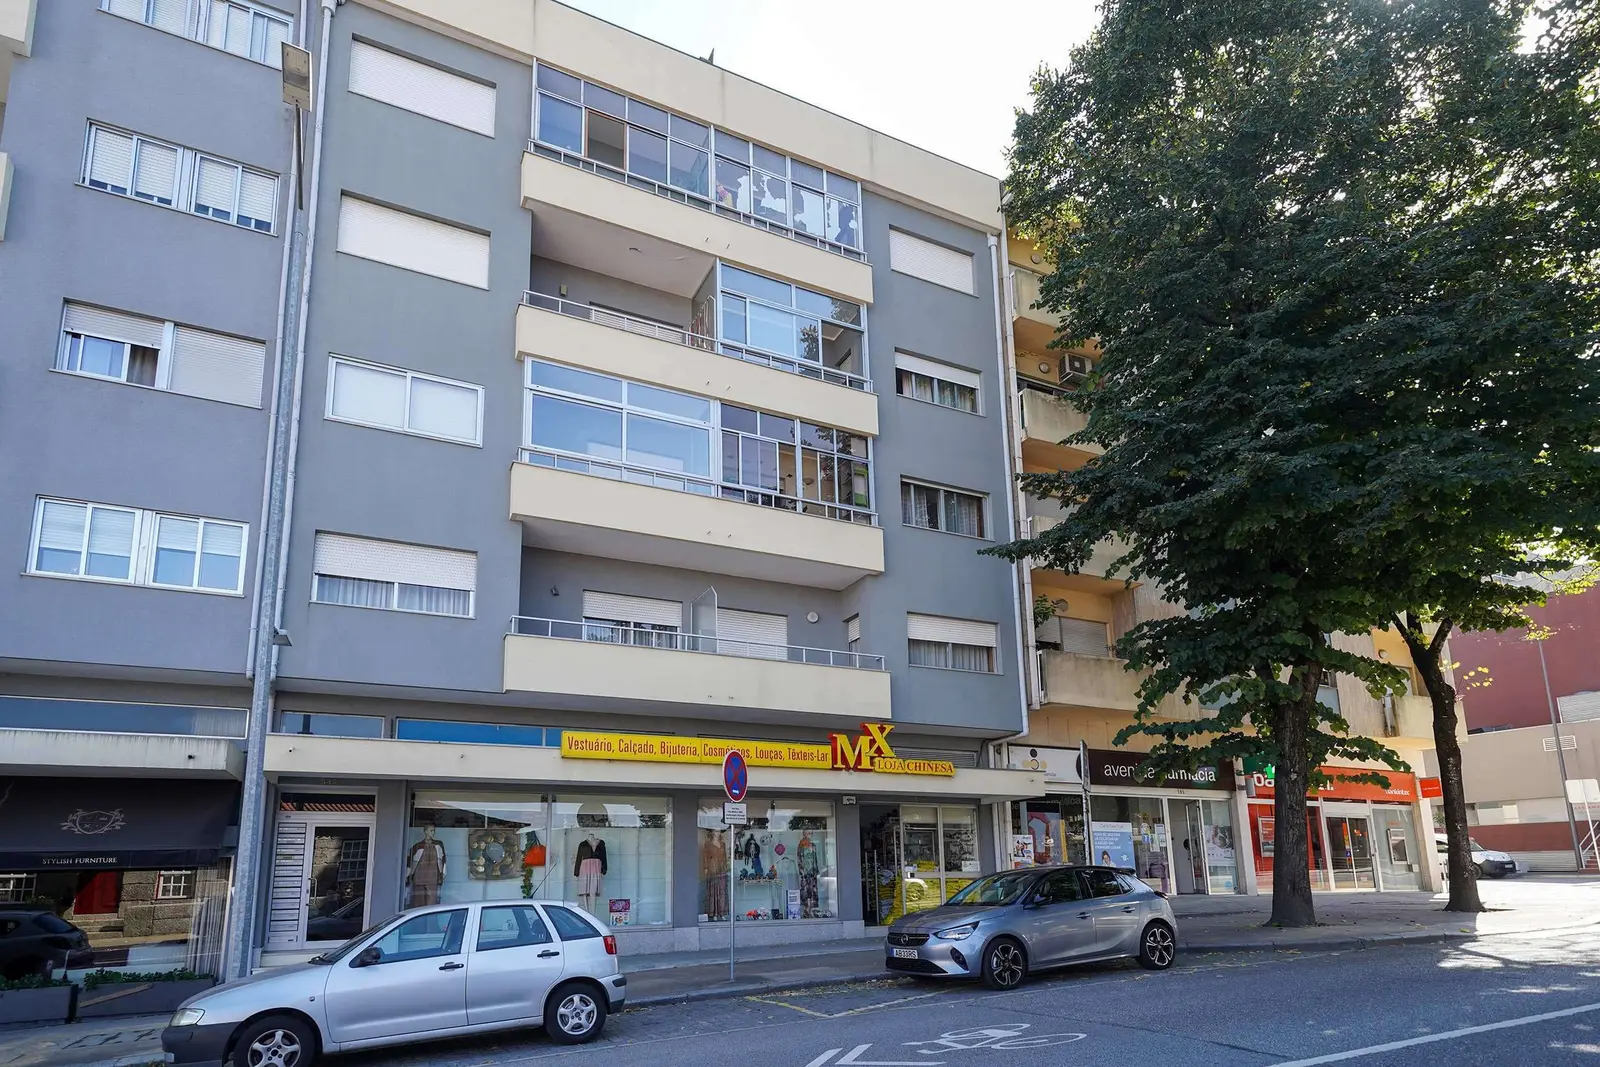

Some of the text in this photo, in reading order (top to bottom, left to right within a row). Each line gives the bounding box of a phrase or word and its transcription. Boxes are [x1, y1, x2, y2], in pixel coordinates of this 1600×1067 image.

[567, 736, 615, 753] Vestuário,
[618, 739, 657, 755] Calçado,
[660, 741, 700, 757] Bijuteria,
[755, 746, 785, 761] Louças,
[787, 747, 828, 762] Têxteis-Lar
[878, 759, 953, 773] LOJA CHINESA
[1104, 763, 1217, 782] avena armcia
